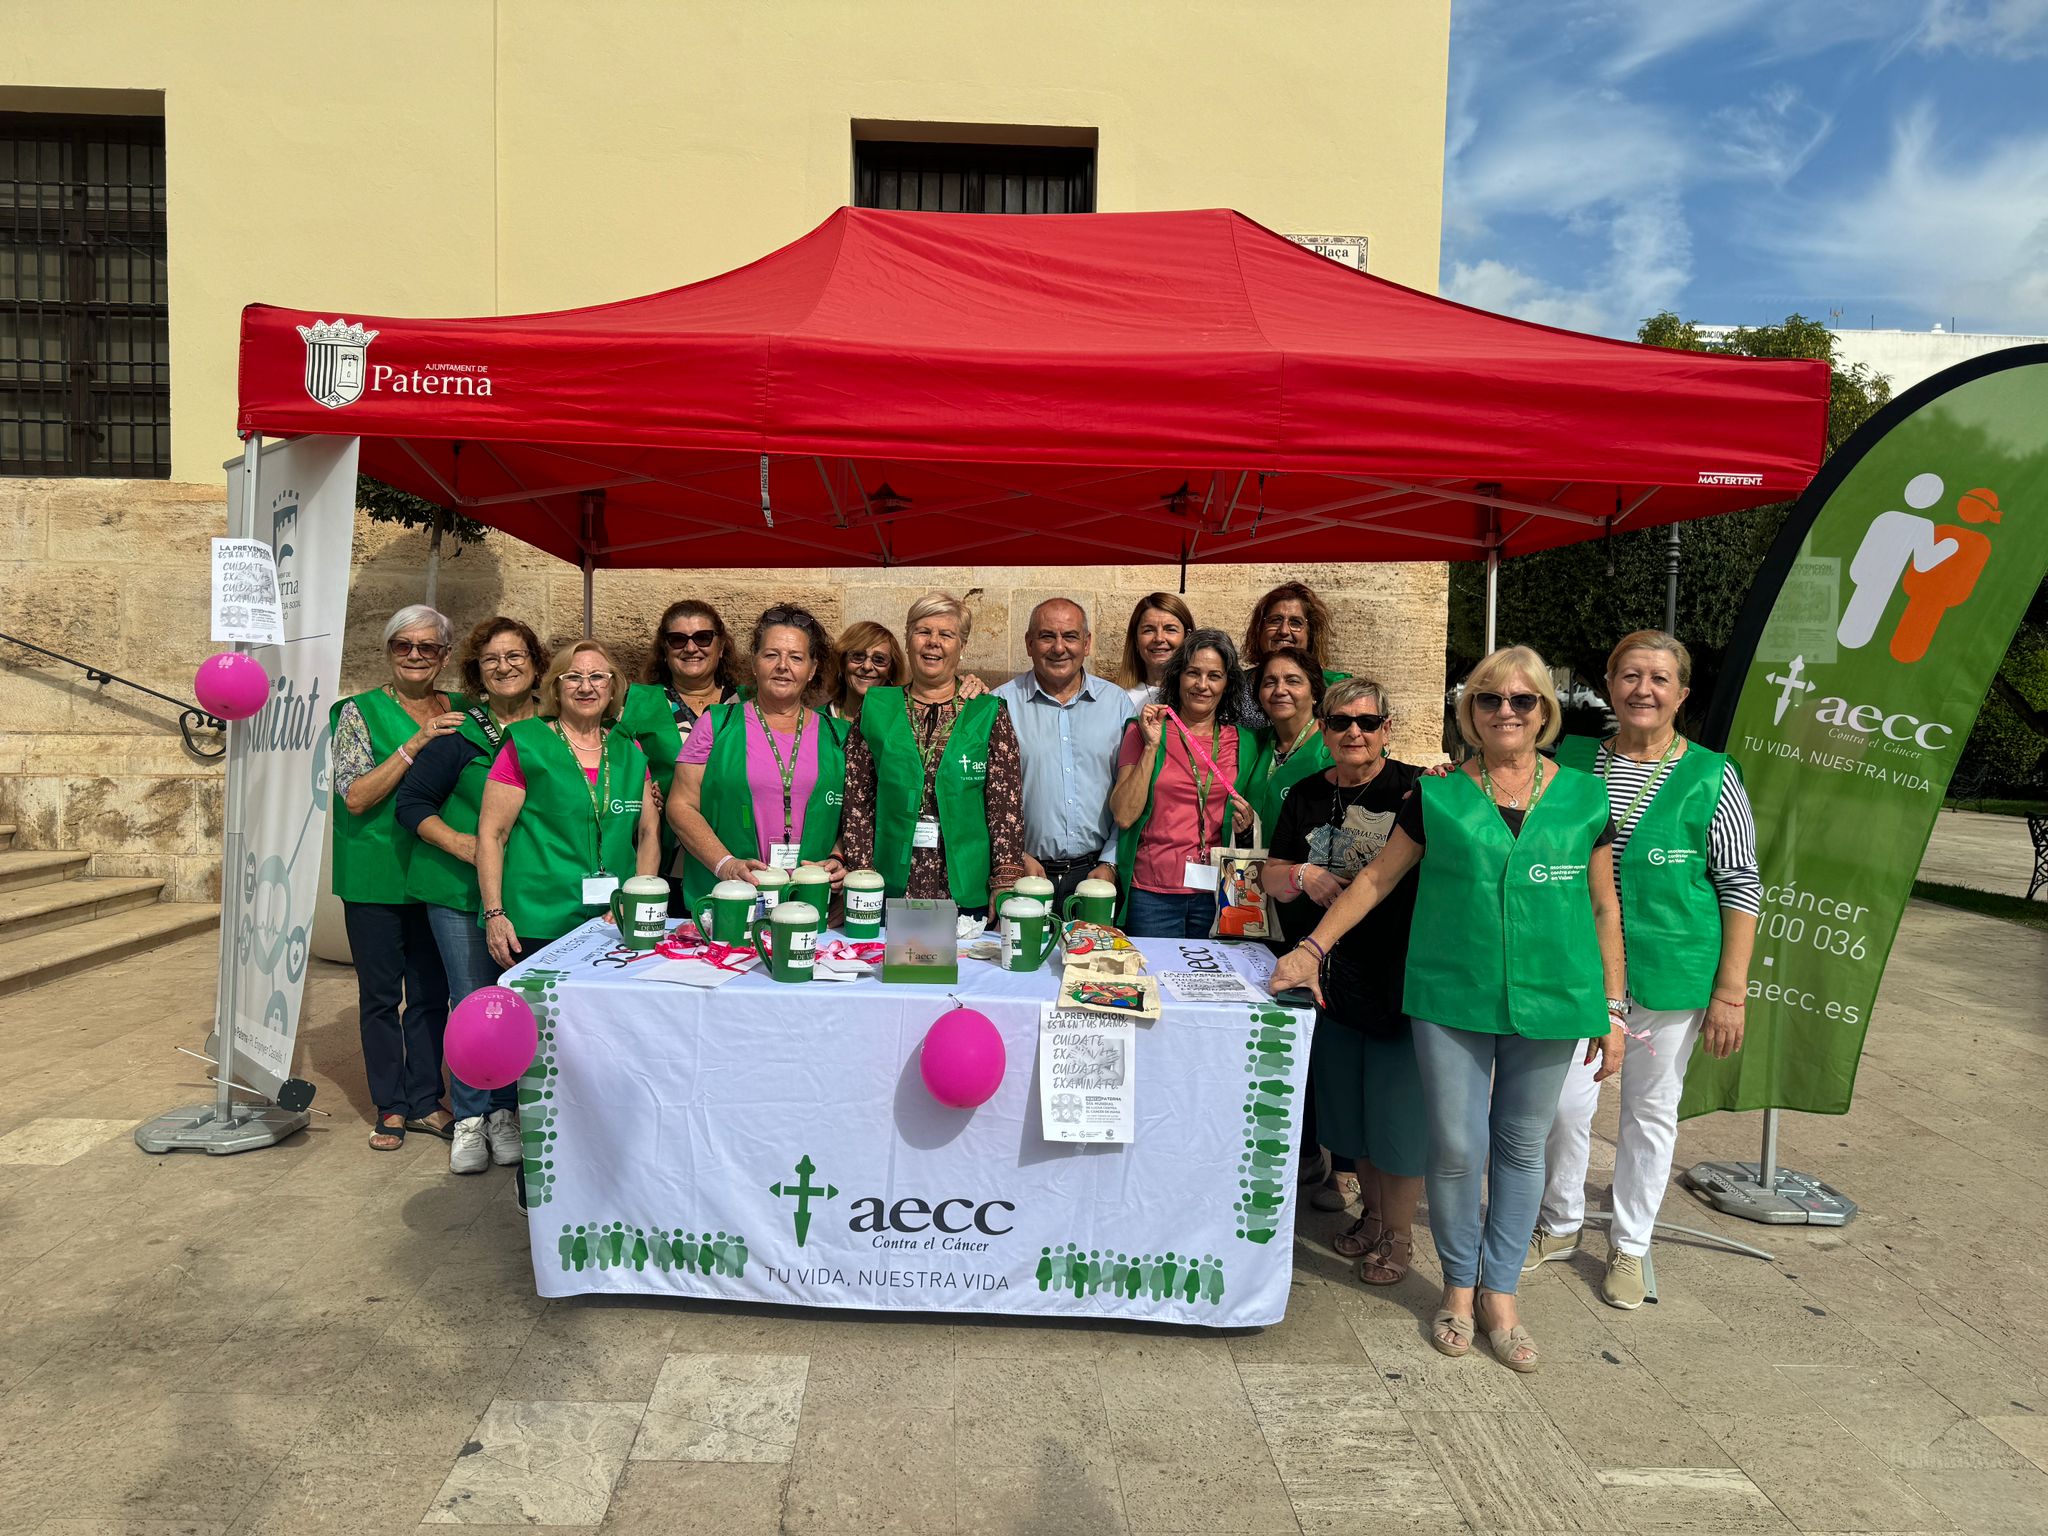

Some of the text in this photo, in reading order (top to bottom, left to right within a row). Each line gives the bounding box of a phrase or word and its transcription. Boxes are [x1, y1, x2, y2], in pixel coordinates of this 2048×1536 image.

[1314, 245, 1349, 259] Plaça
[371, 365, 493, 396] Paterna
[425, 363, 488, 373] AJUNTAMENT DE
[1815, 697, 1953, 750] aecc
[1828, 727, 1923, 760] Contra el Cáncer
[1744, 736, 1930, 793] TU VIDA, NUESTRA VIDA
[1341, 827, 1387, 841] MINIMALISM
[1760, 881, 1869, 924] cáncer
[1813, 925, 1866, 960] 036
[1746, 980, 1860, 1024] aecc.es
[849, 1197, 1016, 1236] aecc
[872, 1235, 989, 1252] Contra el Cáncer
[765, 1266, 1009, 1291] TU VIDA, NUESTRA VIDA
